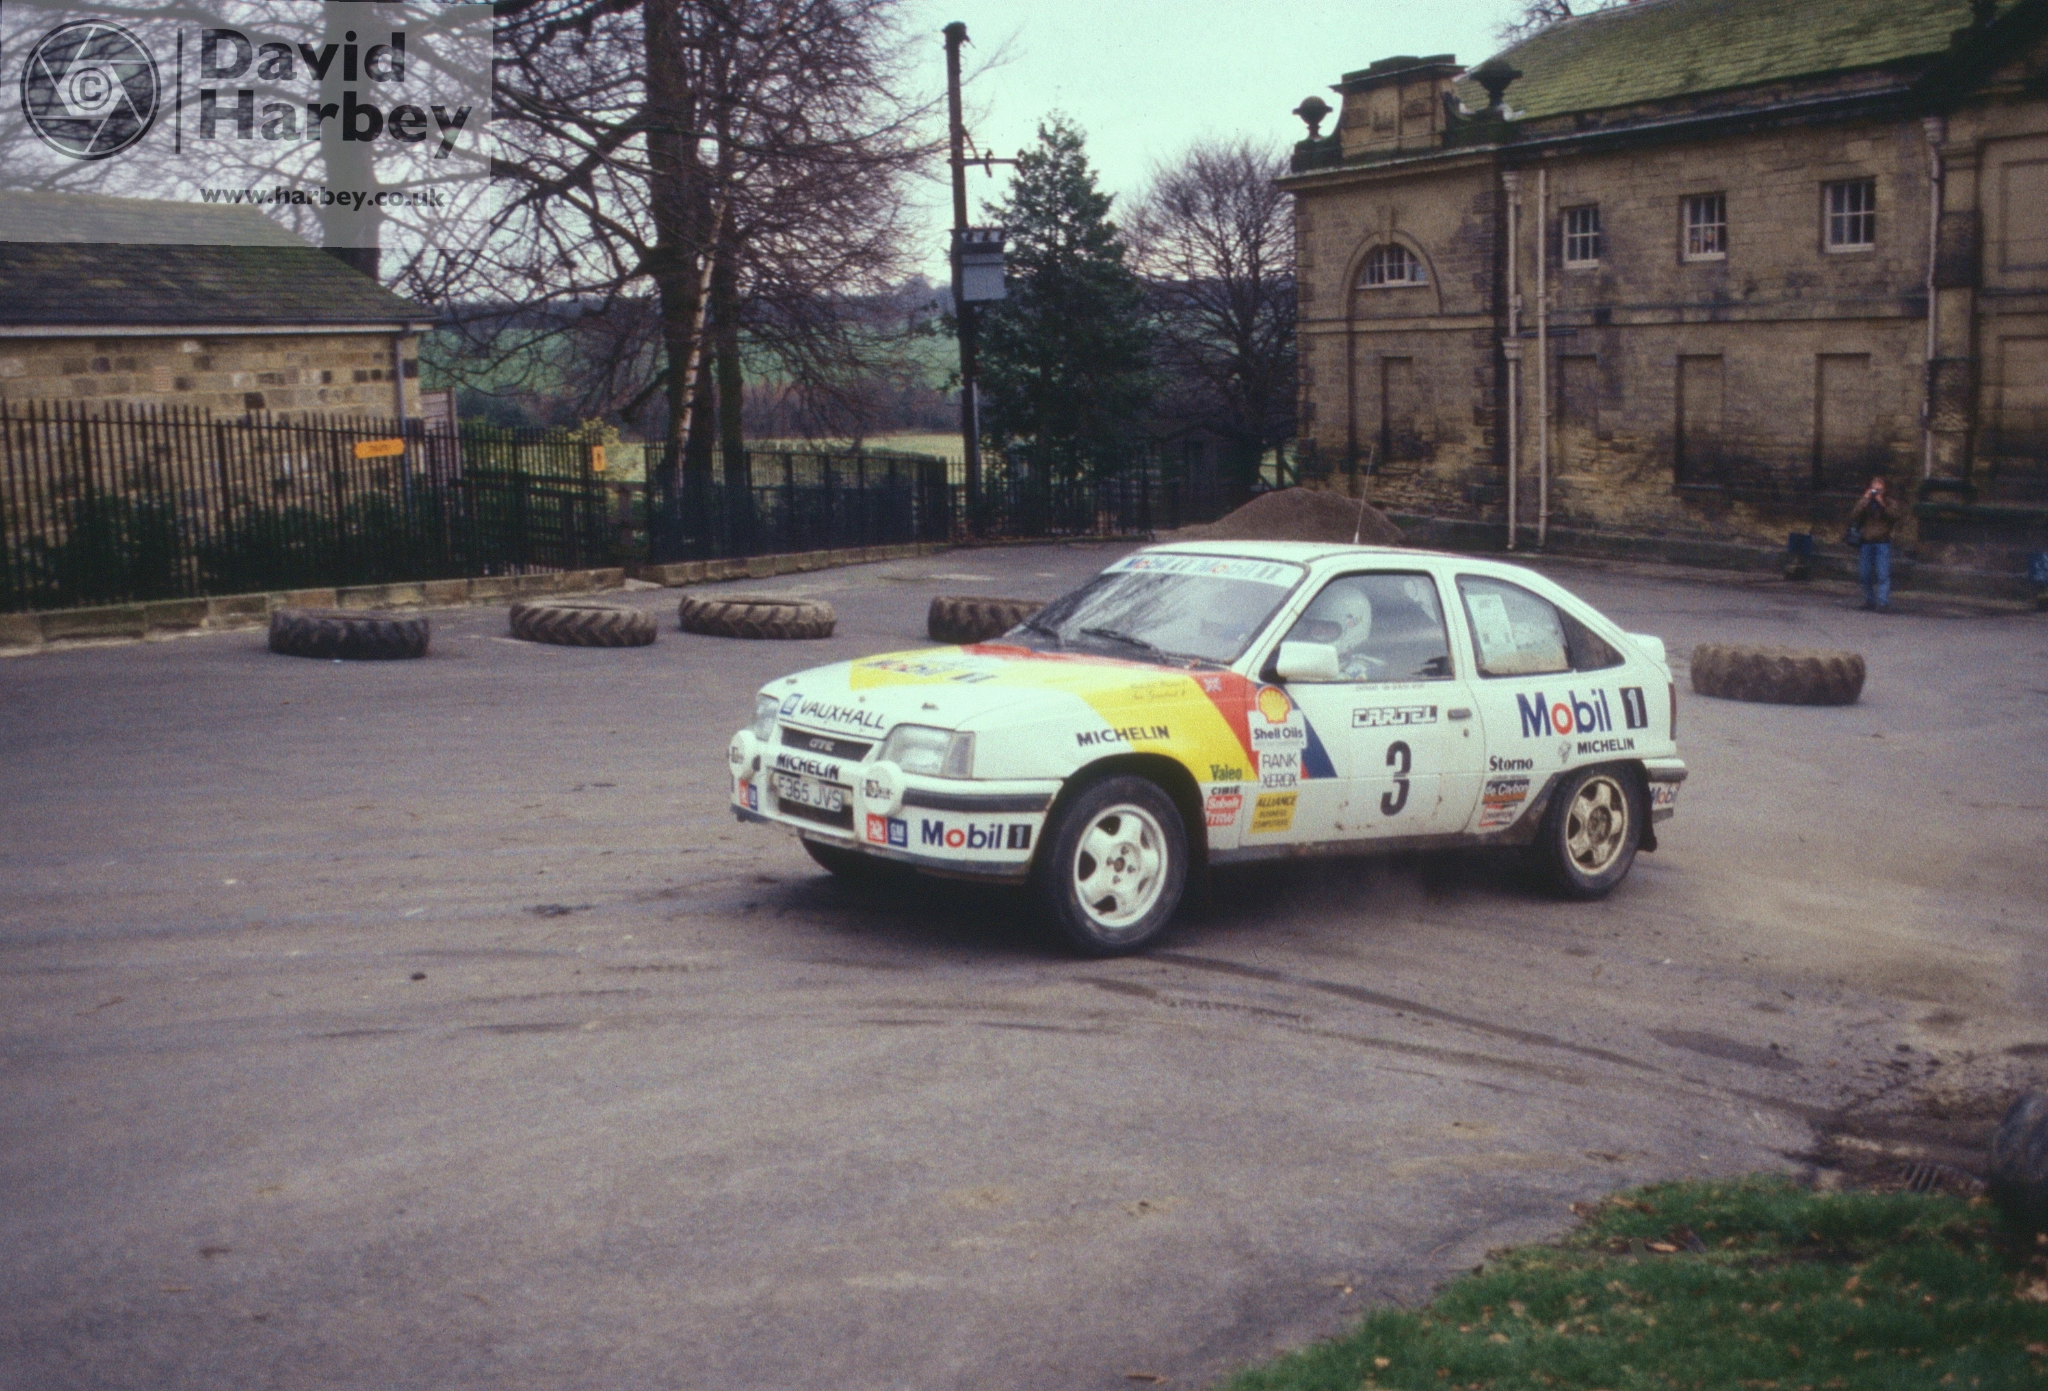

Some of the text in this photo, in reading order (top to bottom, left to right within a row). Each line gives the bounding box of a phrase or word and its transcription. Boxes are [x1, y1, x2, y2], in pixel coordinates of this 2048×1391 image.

[800, 699, 886, 730] VAUXHALL
[1353, 705, 1437, 728] CARTEL
[1515, 688, 1613, 738] Mobil
[1075, 725, 1170, 747] MICHELIN
[1253, 727, 1304, 740] Shell Oils
[1577, 738, 1635, 755] MICHELIN
[777, 753, 841, 780] MICHELIN
[1262, 753, 1298, 769] RANK
[1489, 755, 1534, 771] Storno
[1209, 764, 1242, 781] Valeo
[1380, 740, 1412, 816] 3
[921, 818, 1004, 849] Mobil
